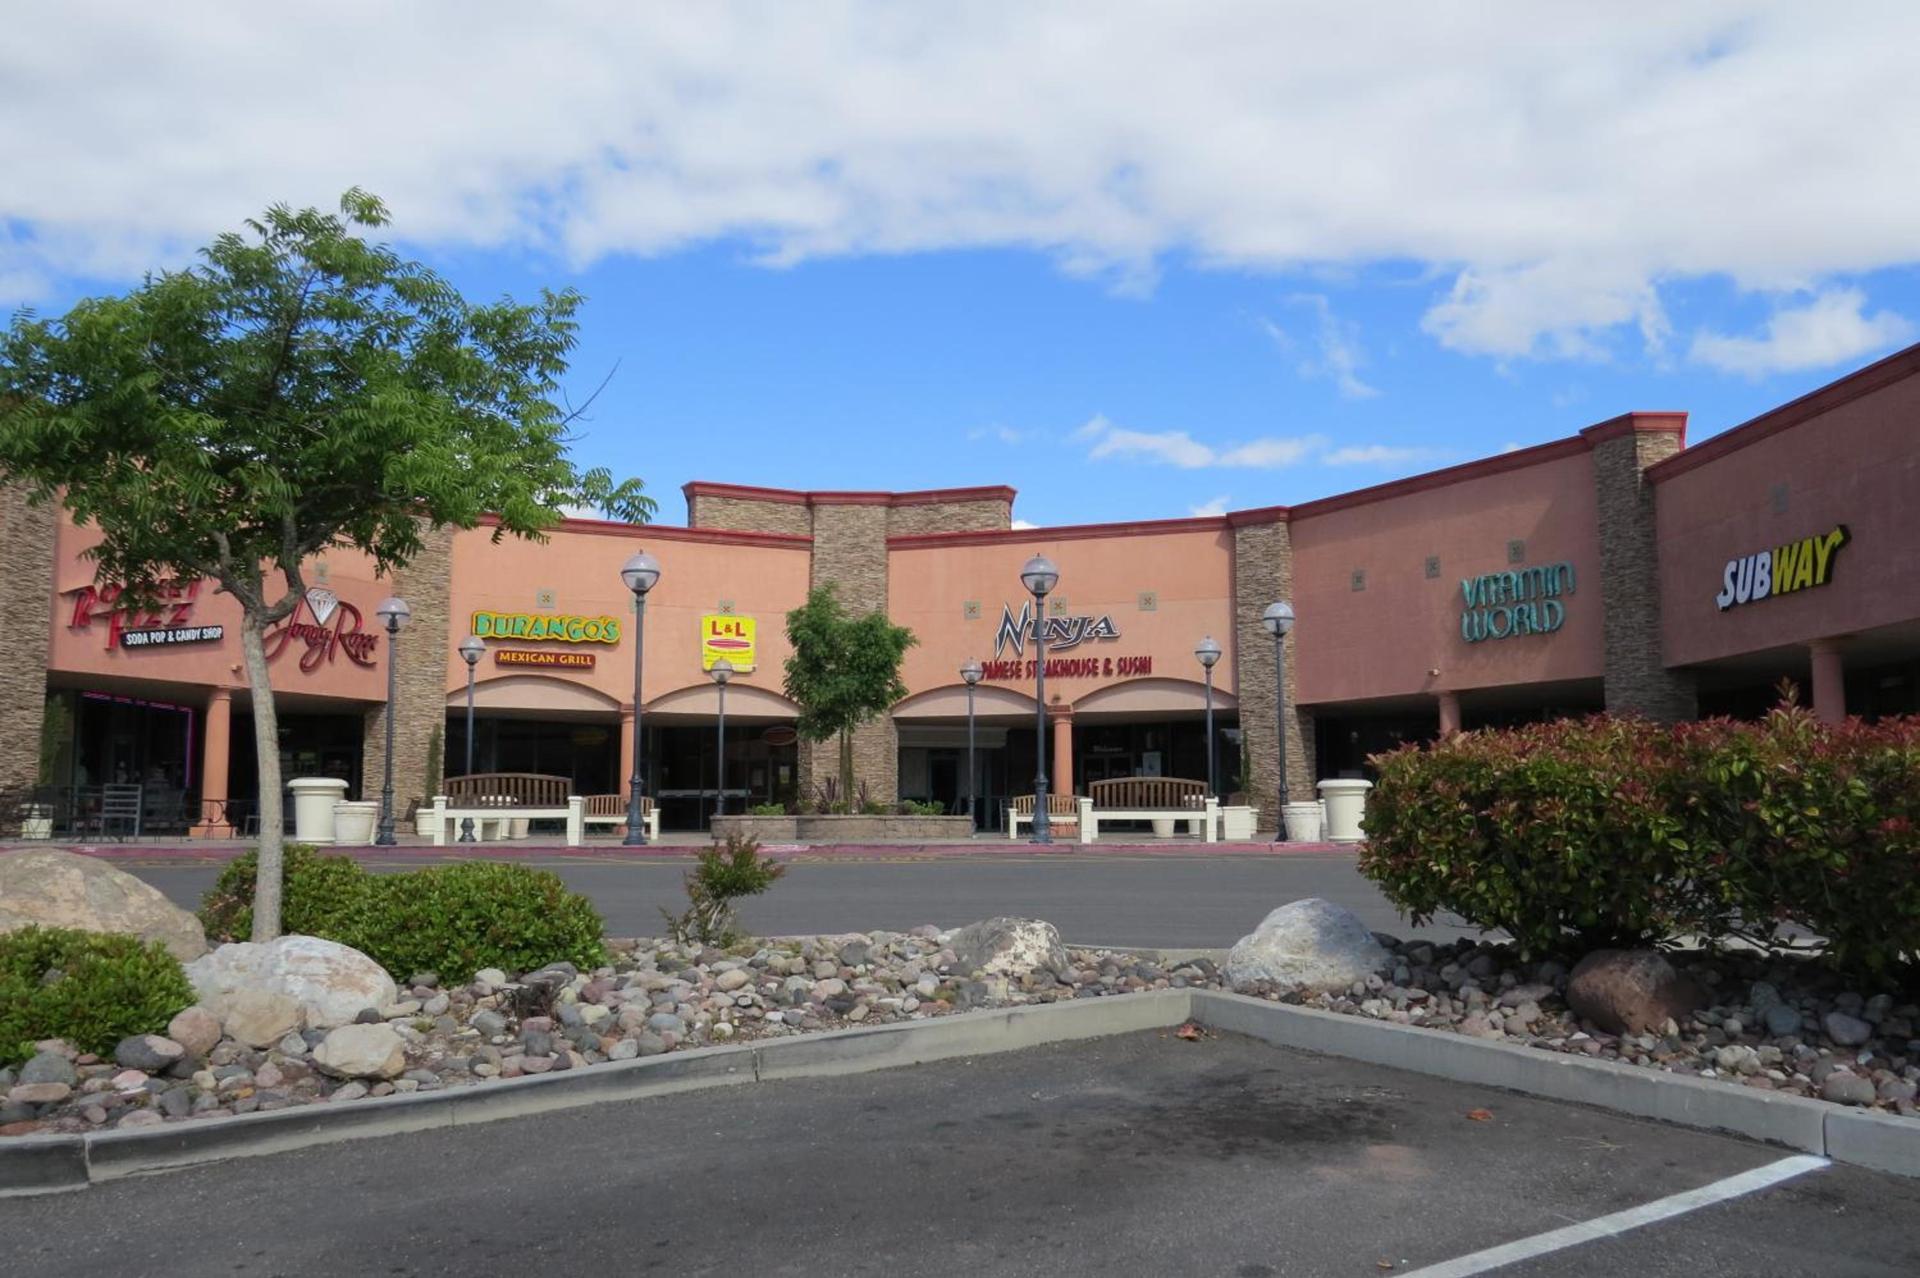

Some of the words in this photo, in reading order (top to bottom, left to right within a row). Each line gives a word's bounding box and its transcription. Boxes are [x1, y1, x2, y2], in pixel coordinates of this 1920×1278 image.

[1716, 526, 1844, 610] SUBWAY
[1460, 561, 1576, 609] VITAMIN
[474, 612, 619, 641] DURANGO'S
[712, 620, 746, 637] L&L
[995, 600, 1121, 659] NINJA
[1461, 599, 1565, 642] WORLD
[126, 632, 149, 645] SODA
[151, 630, 166, 643] POP
[168, 631, 175, 642] &
[176, 628, 201, 642] CANDY
[203, 626, 223, 640] SHOP
[500, 652, 555, 663] MEXICAN
[560, 654, 592, 665] GRILL
[1026, 656, 1099, 679] STAKHOUSE
[1102, 657, 1113, 676] &
[1117, 655, 1152, 677] SUSHI
